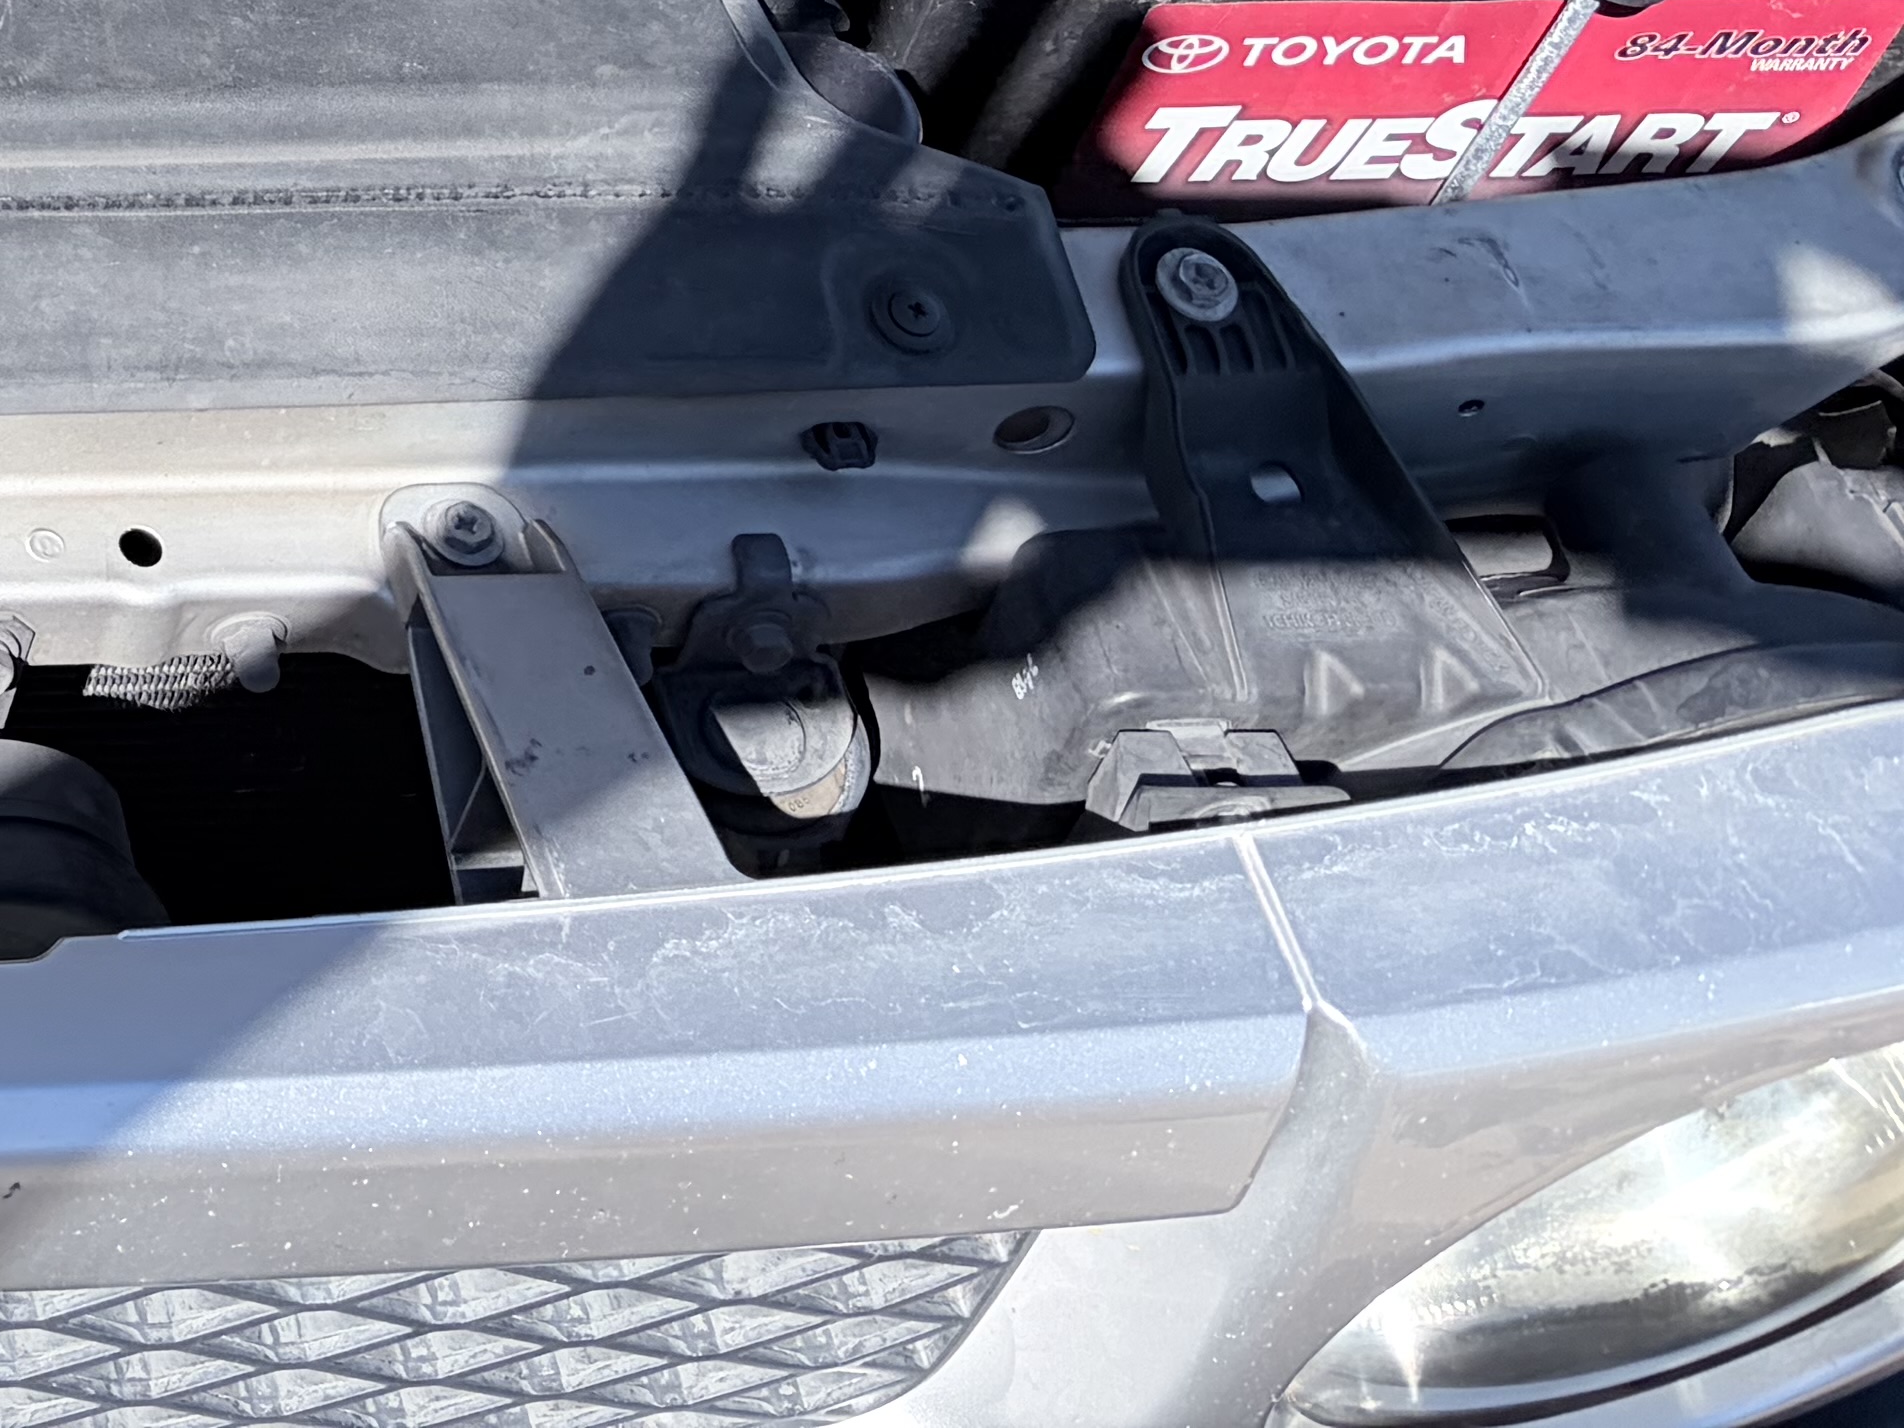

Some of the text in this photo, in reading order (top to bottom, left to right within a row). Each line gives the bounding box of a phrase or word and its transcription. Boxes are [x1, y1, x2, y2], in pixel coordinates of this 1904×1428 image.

[1242, 35, 1466, 68] TOYOTA
[1614, 28, 1873, 61] 84-Month
[1750, 57, 1855, 72] WARRANTY
